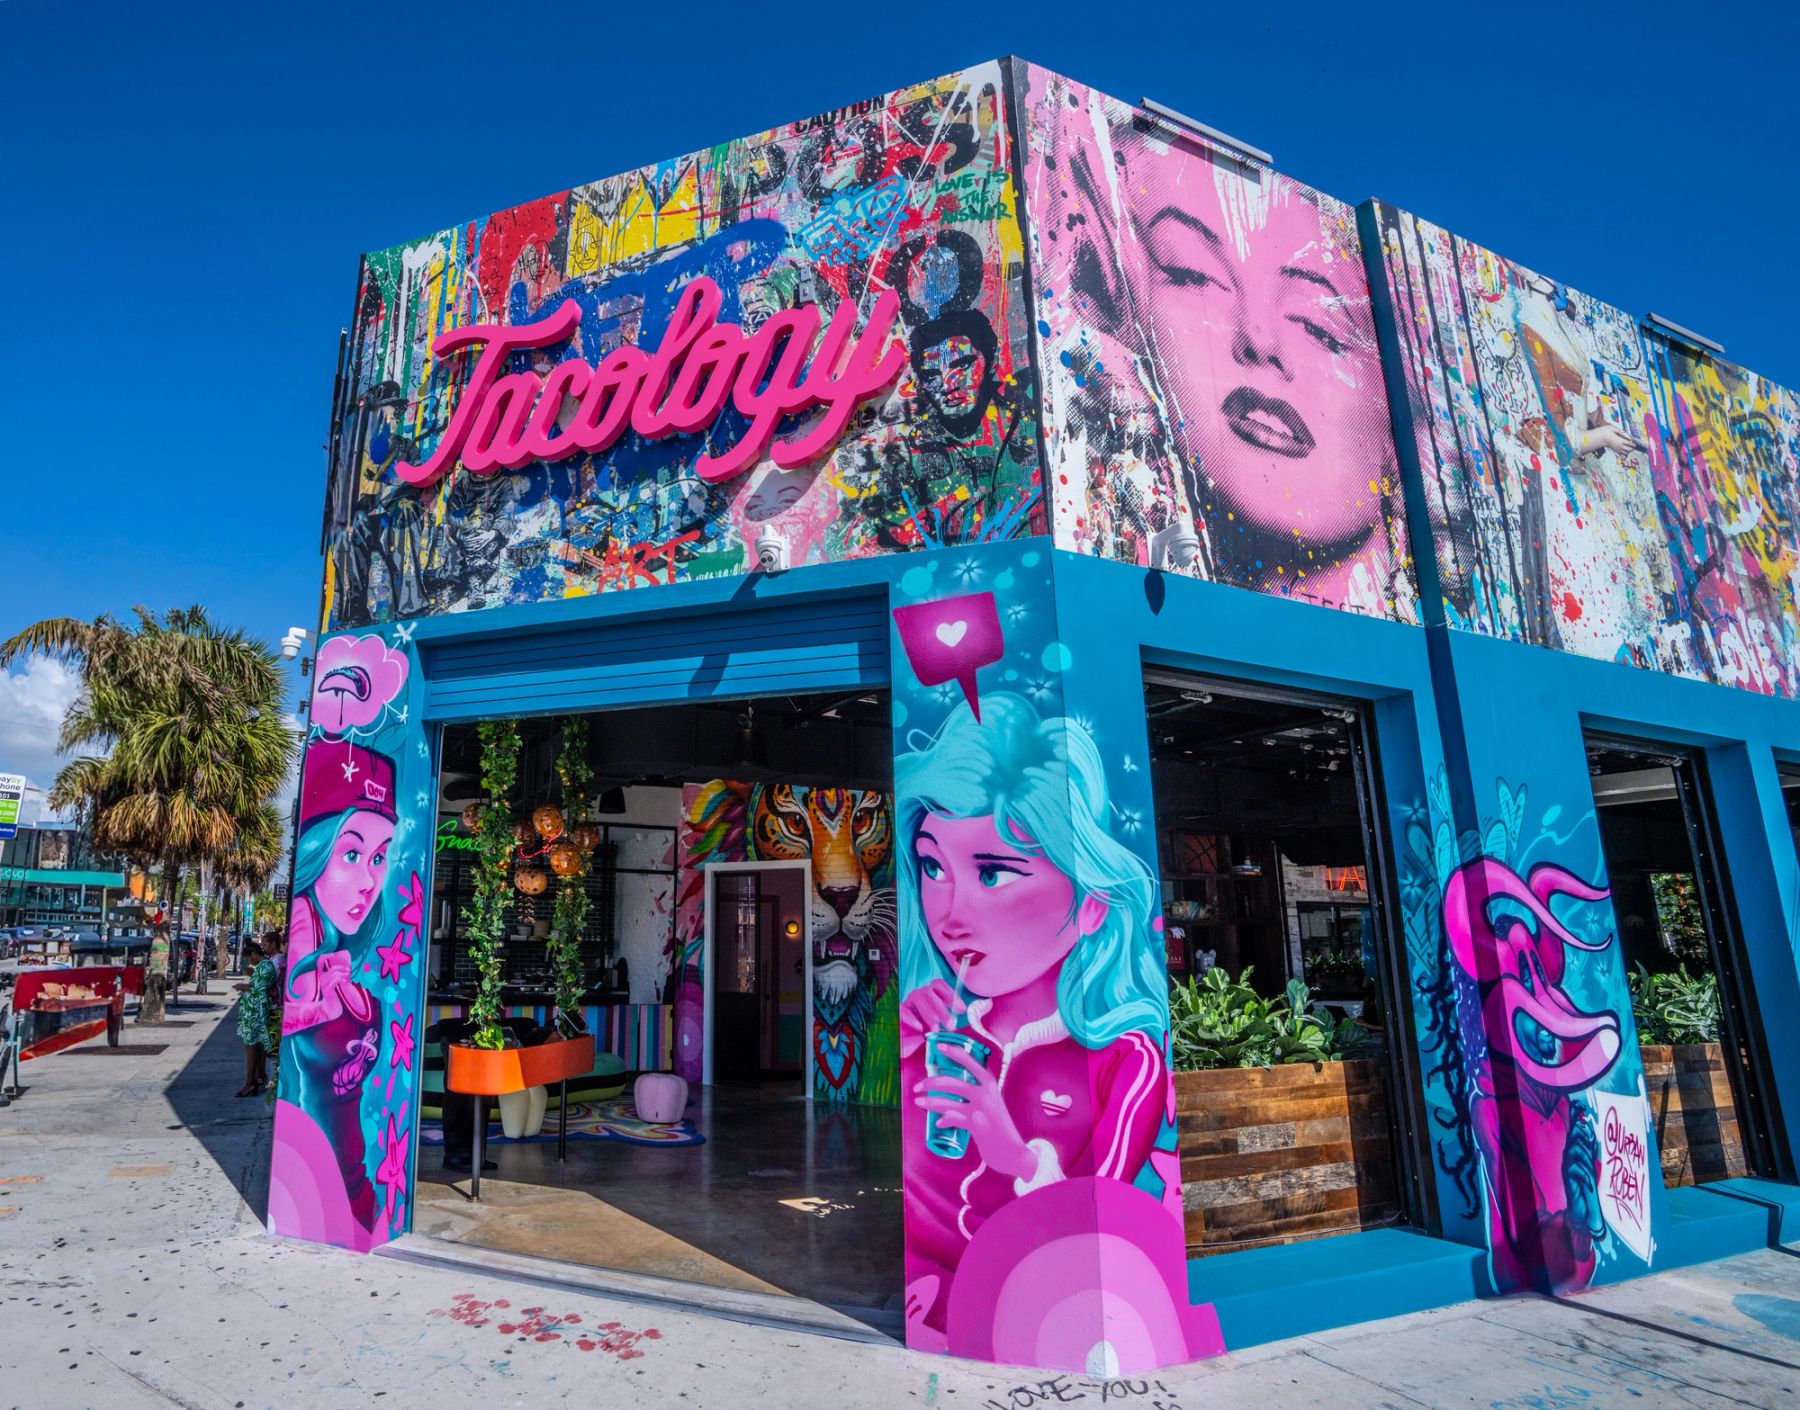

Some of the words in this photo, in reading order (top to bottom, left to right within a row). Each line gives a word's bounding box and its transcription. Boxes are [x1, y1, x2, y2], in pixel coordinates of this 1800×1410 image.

[795, 95, 886, 133] CAUTION
[934, 173, 976, 194] LOVE
[958, 189, 991, 206] THE
[940, 201, 1013, 225] ANSWER
[395, 276, 907, 488] Tacology
[597, 529, 701, 594] ART
[1604, 1105, 1646, 1172] @URBAN
[1606, 1155, 1646, 1222] RUBEN
